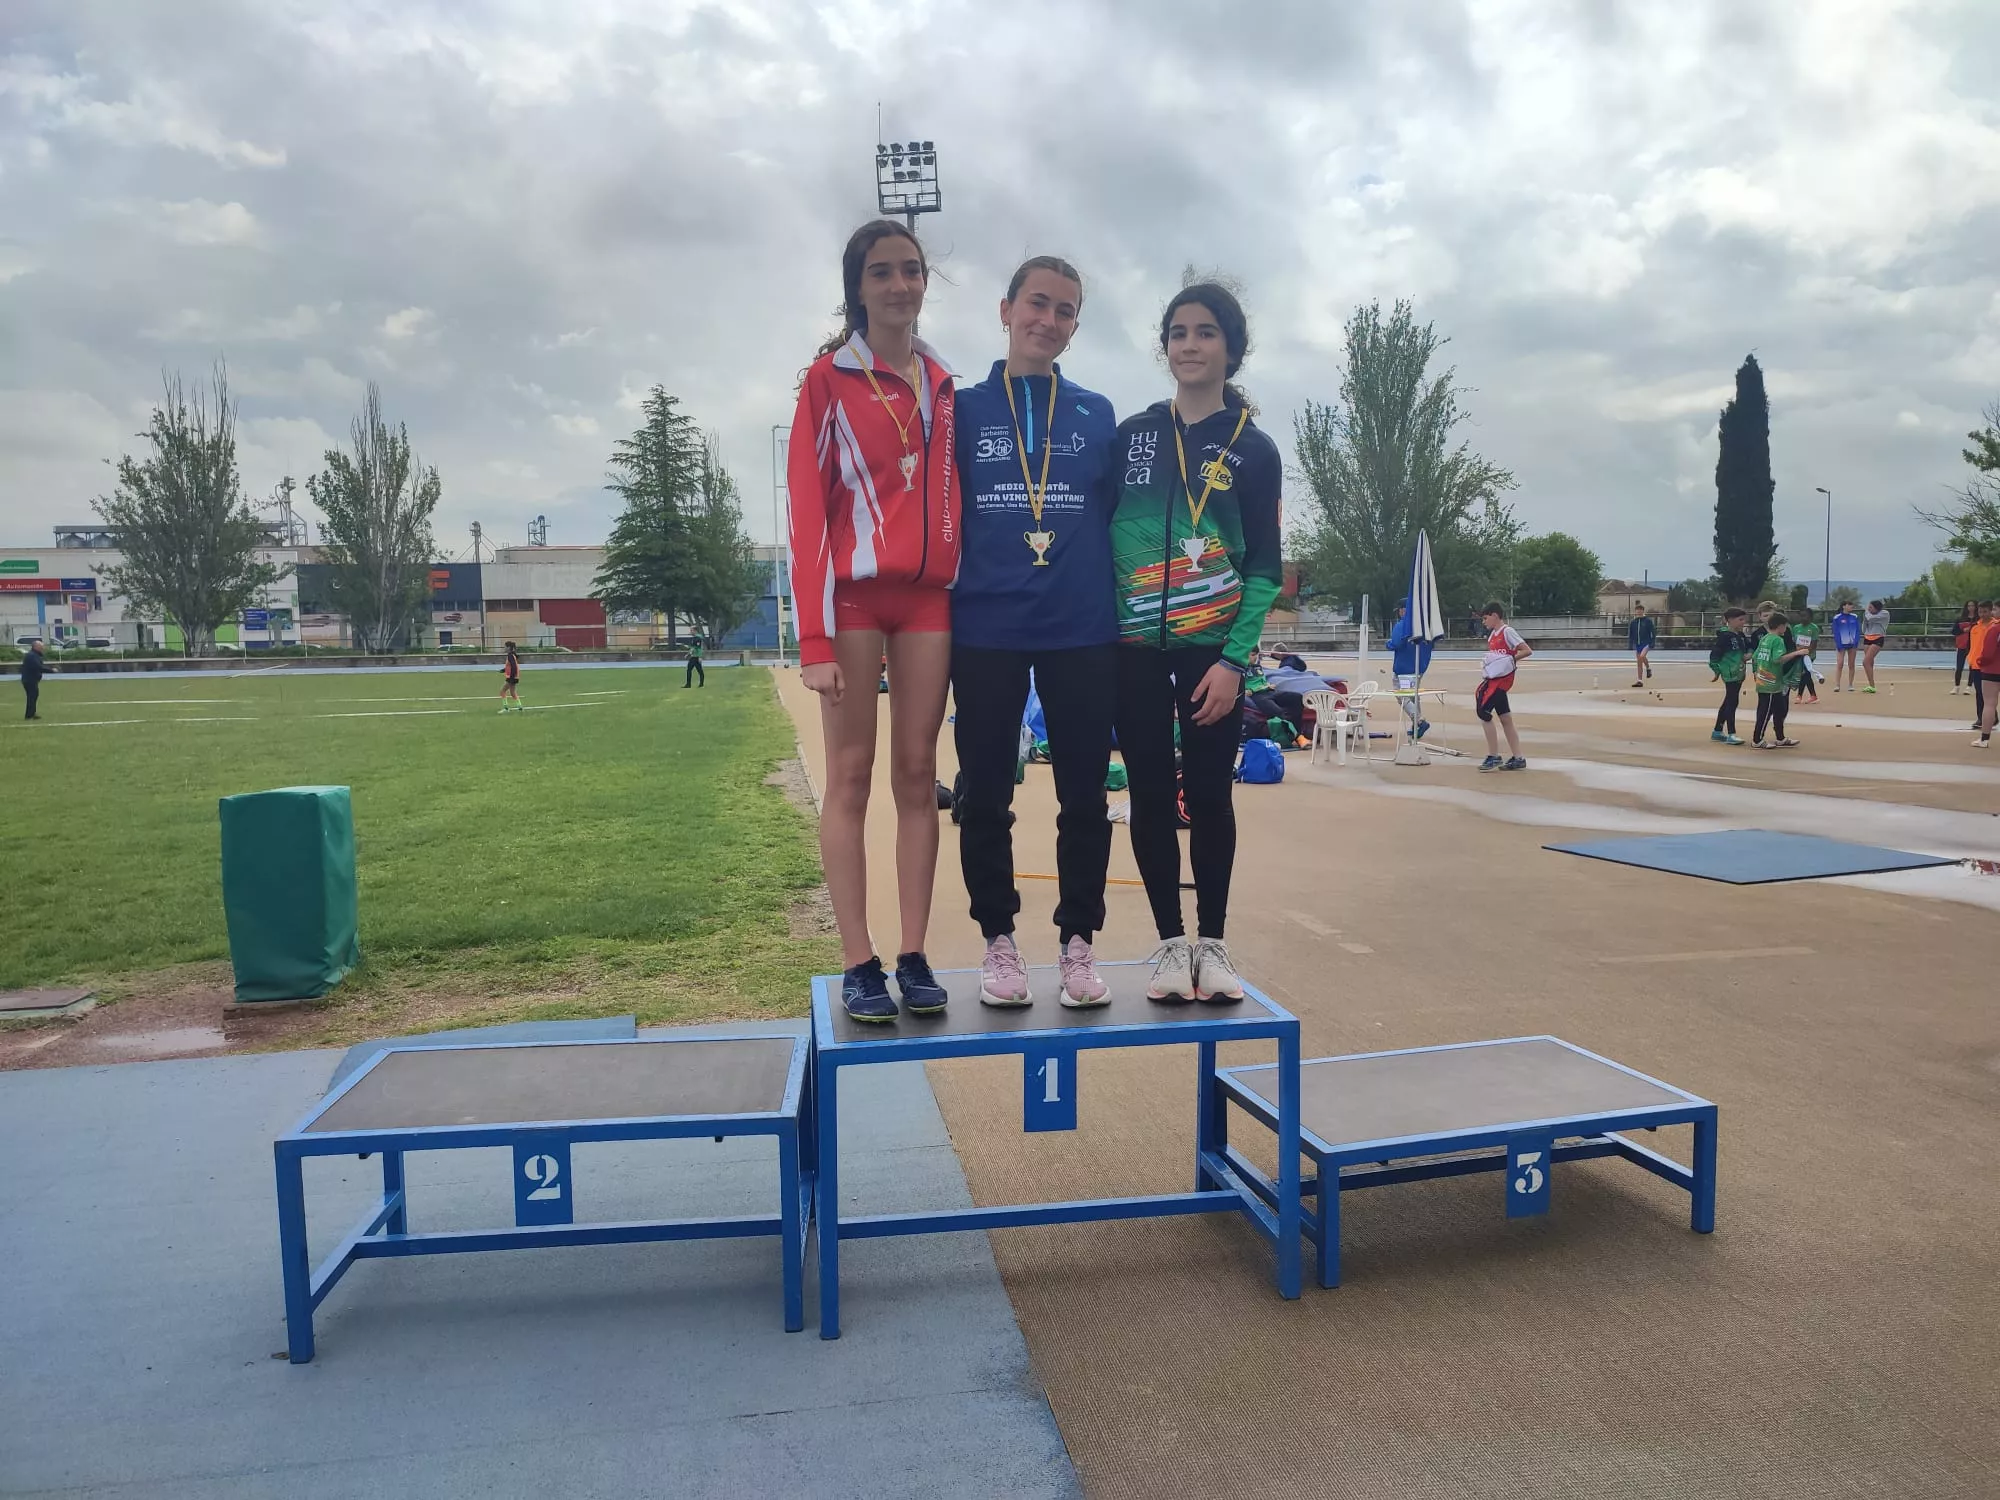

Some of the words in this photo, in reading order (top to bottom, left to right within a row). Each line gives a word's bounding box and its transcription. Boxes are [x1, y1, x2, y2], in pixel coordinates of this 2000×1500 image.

[976, 494, 1001, 503] RUTA
[1002, 494, 1029, 502] VINO
[994, 483, 1025, 491] MEDIO
[1027, 482, 1070, 492] AATÓN
[1037, 1057, 1061, 1103] 1
[524, 1154, 561, 1201] 2
[1514, 1151, 1544, 1194] 3
